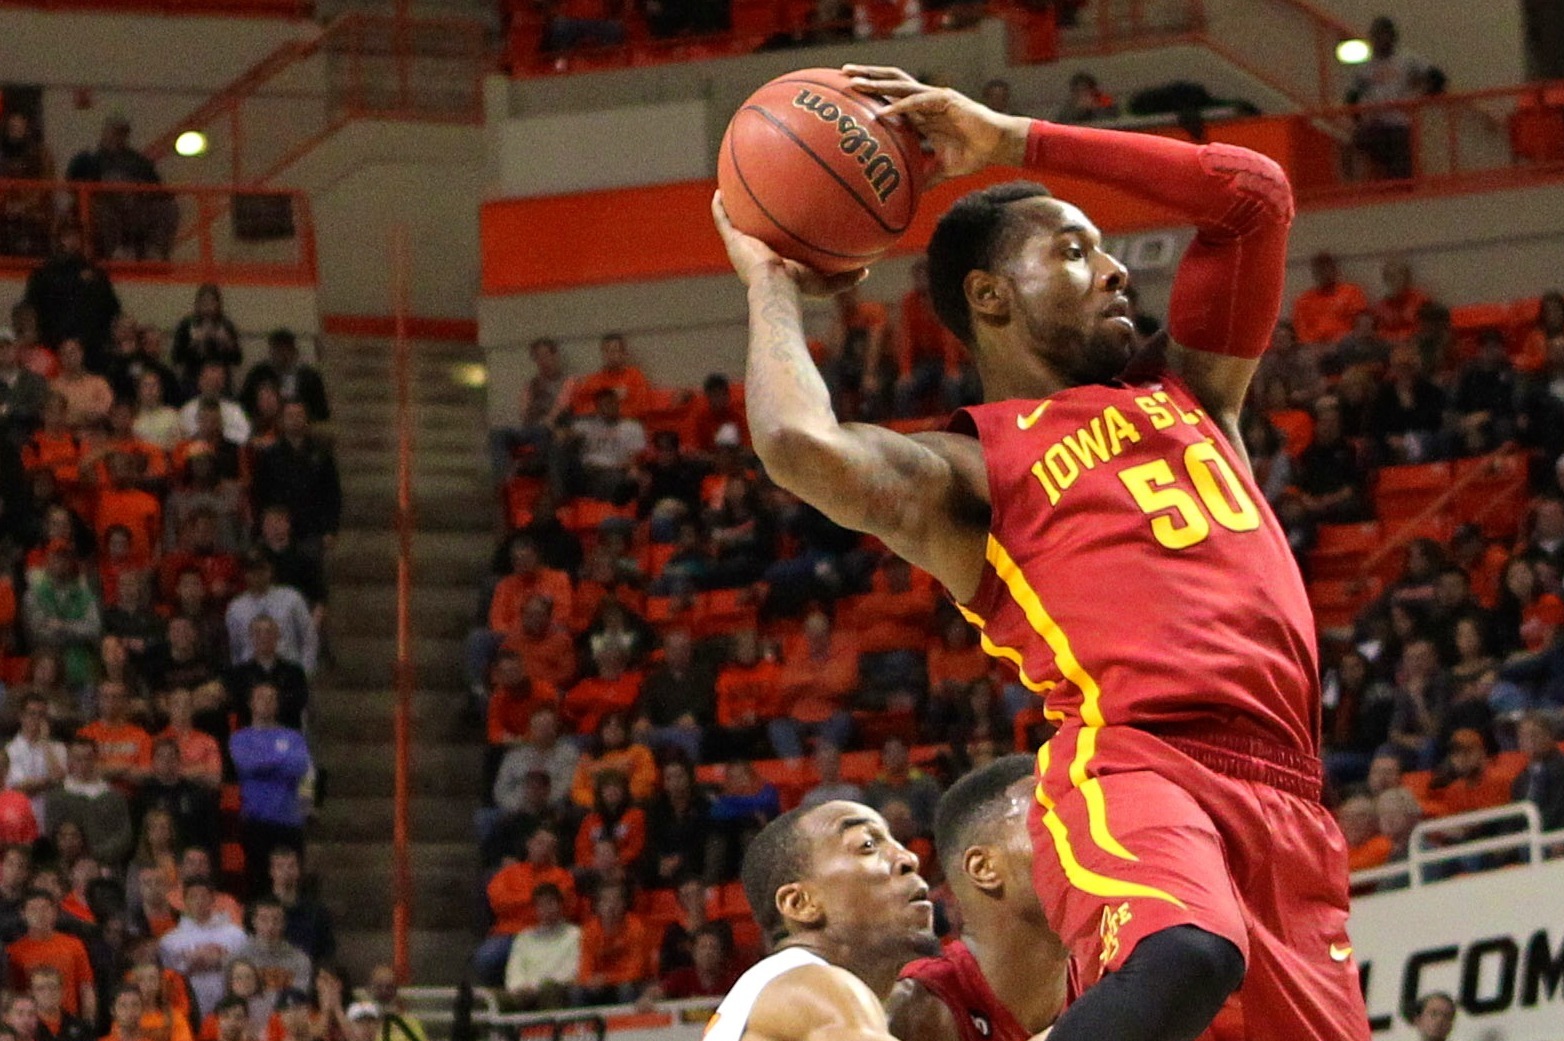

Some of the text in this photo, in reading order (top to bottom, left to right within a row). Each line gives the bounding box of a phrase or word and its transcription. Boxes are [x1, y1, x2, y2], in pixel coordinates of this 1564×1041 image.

[793, 88, 901, 204] Wilson
[1031, 405, 1141, 506] IOWA
[1117, 441, 1261, 549] 50
